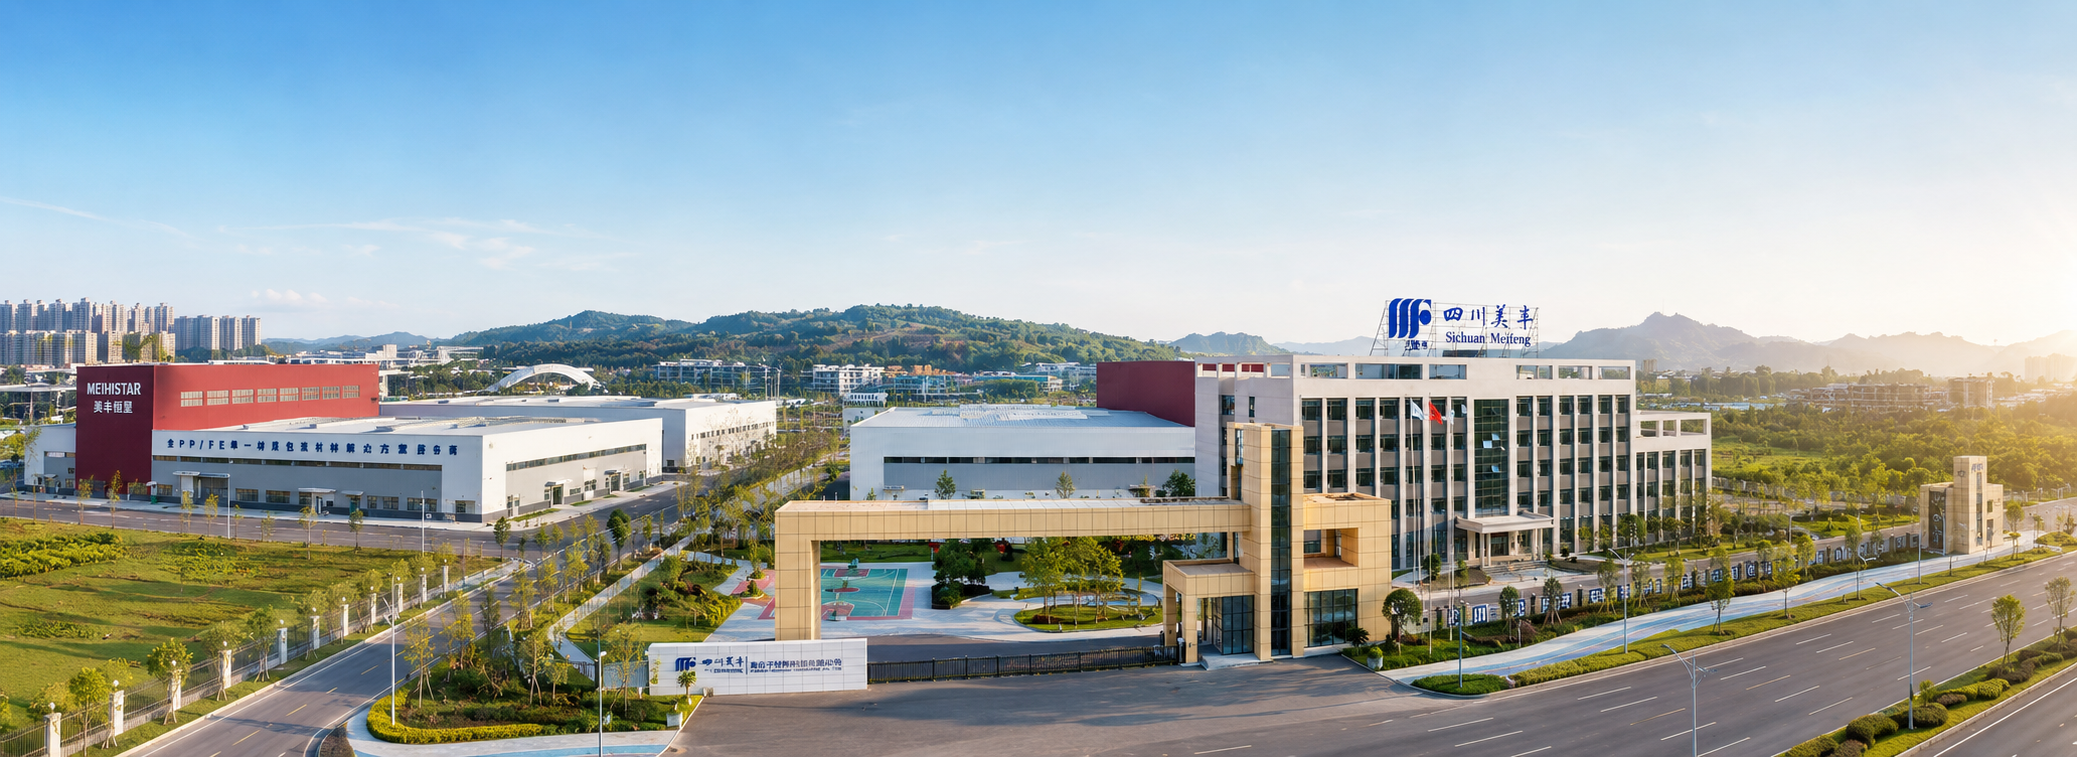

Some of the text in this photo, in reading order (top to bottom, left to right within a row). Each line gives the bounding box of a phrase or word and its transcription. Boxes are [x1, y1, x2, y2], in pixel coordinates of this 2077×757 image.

[1443, 304, 1533, 330] 四川美丰
[1445, 332, 1531, 347] Sichuan Meifeng
[87, 382, 141, 395] MEIHISTAR
